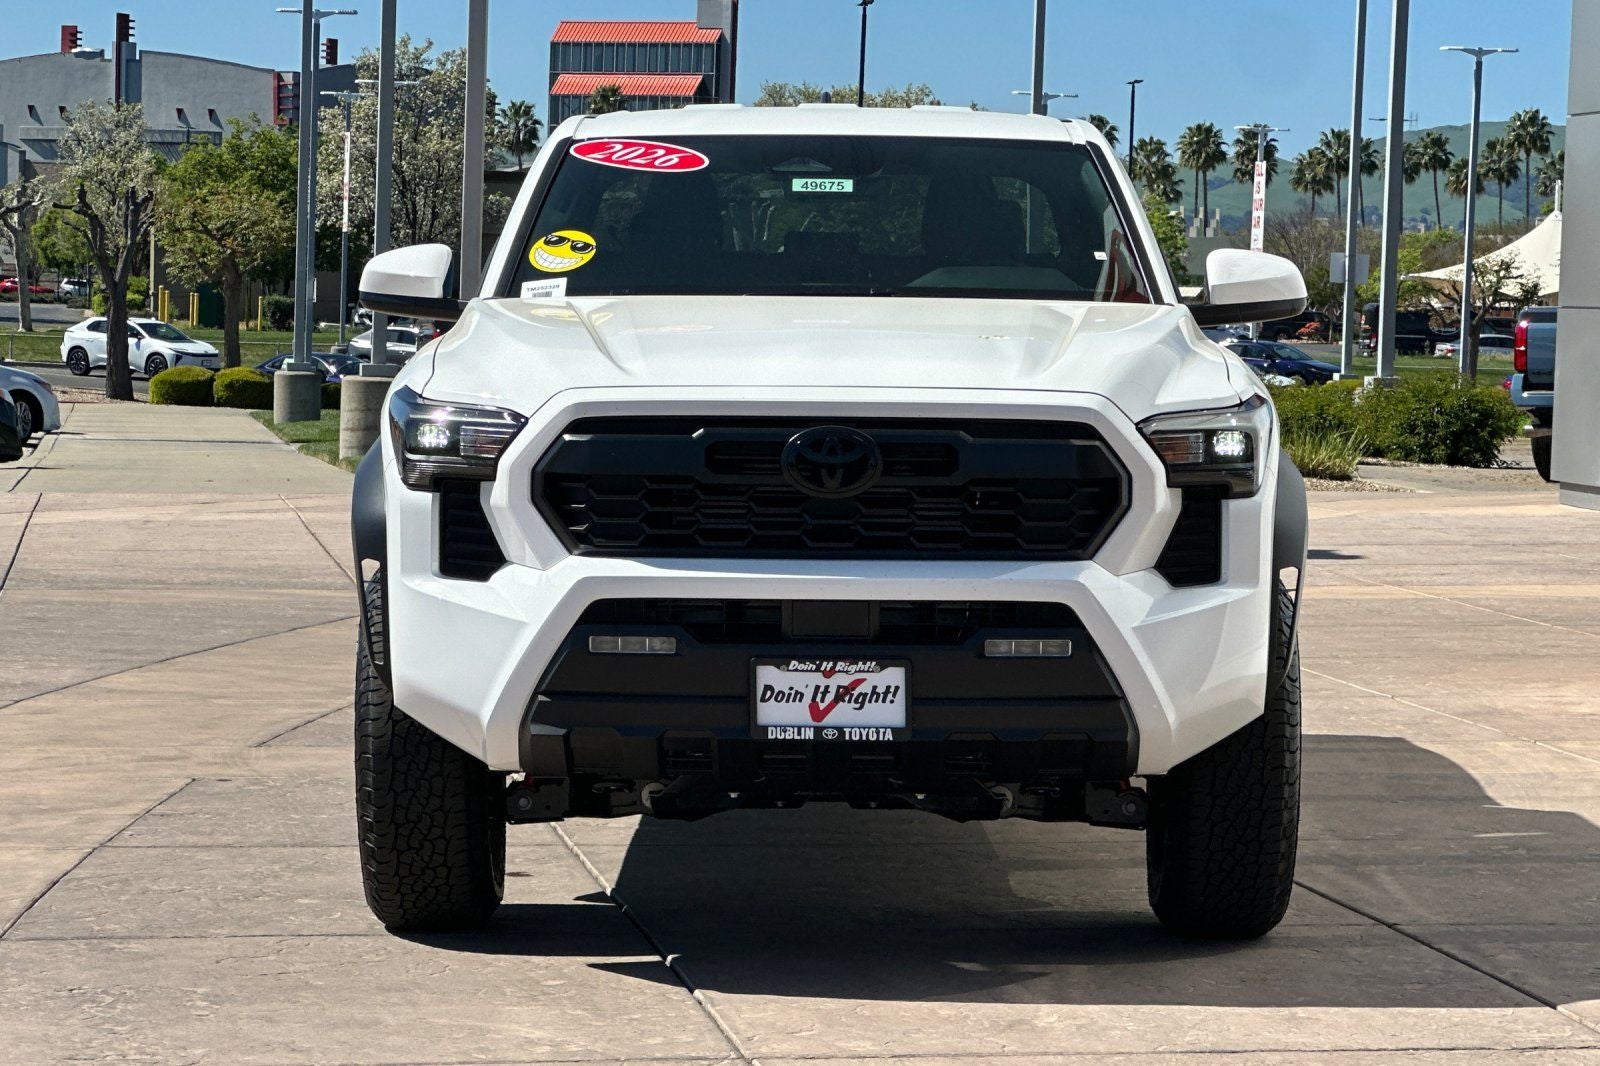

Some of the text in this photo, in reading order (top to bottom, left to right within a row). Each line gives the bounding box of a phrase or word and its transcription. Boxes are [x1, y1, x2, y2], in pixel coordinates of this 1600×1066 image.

[586, 143, 693, 167] 2026
[800, 180, 845, 191] 49675
[788, 660, 877, 675] Doin' It Right!
[760, 684, 901, 711] Doin' It Right!
[767, 726, 894, 741] DUBLIN TOYOTA
